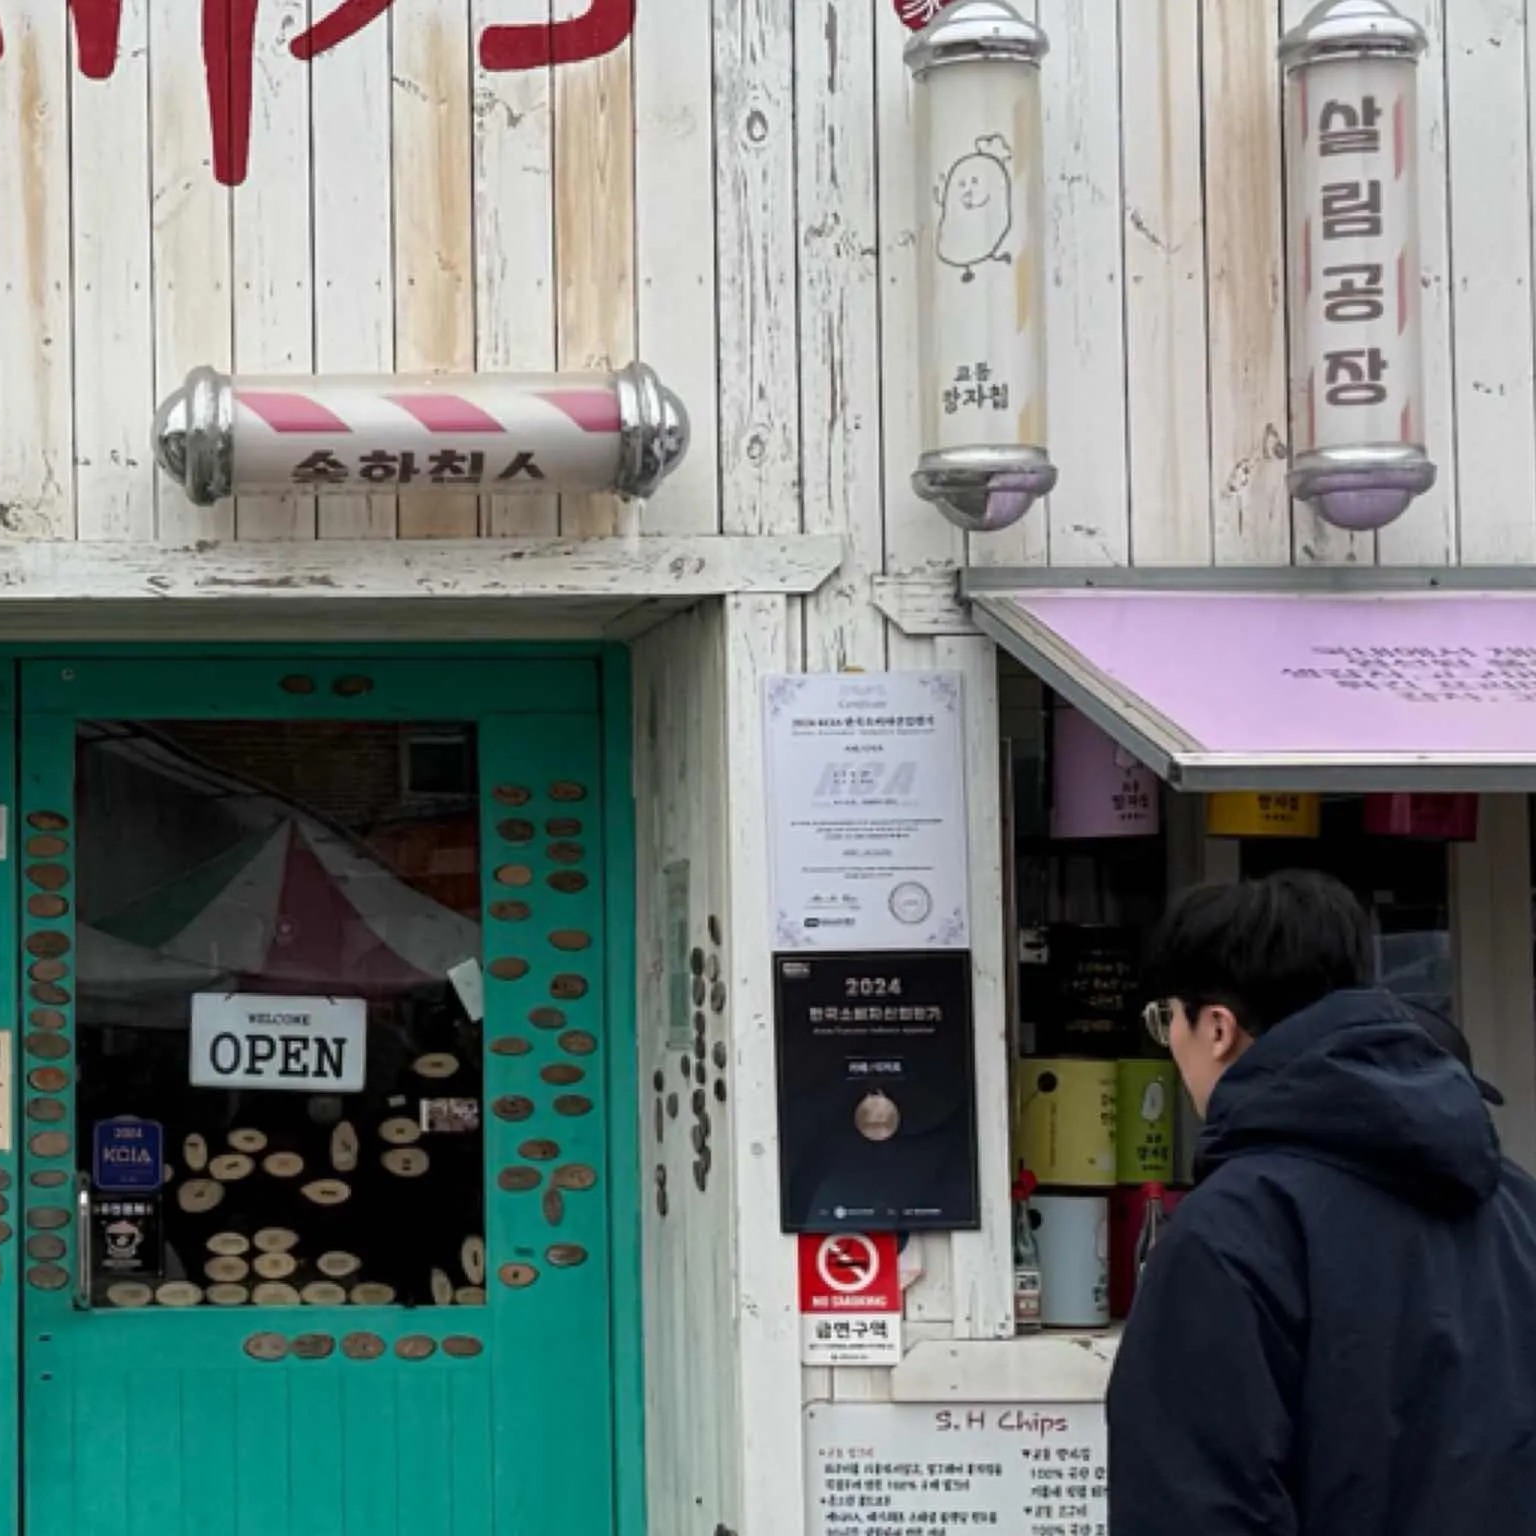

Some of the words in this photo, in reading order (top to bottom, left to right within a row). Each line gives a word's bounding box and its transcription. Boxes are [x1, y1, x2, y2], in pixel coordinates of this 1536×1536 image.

[1318, 96, 1389, 407] 살림공장
[845, 977, 902, 996] 2024
[248, 1013, 311, 1026] WELCOME
[210, 1032, 347, 1079] OPEN
[815, 1320, 890, 1340] 금연구역
[999, 1409, 1069, 1437] Chips
